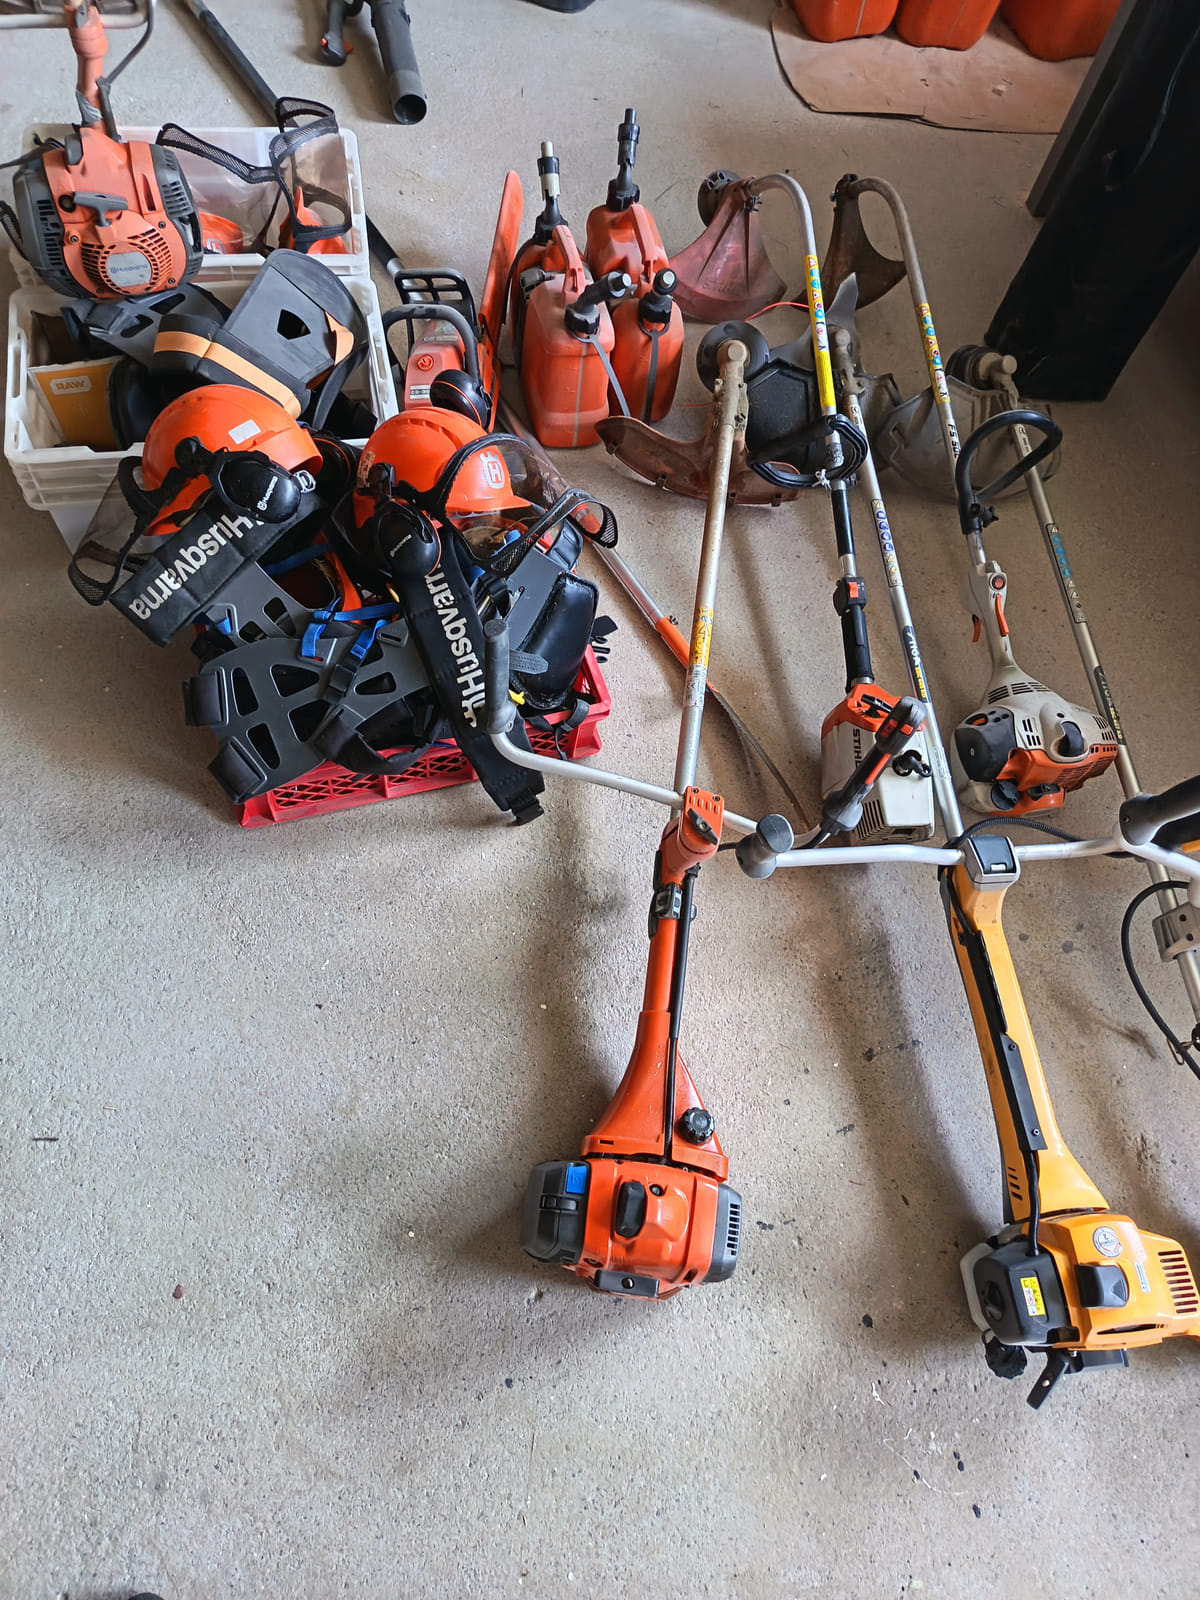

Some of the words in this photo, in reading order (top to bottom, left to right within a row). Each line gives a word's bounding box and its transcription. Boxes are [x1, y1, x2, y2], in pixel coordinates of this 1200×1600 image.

[55, 381, 85, 391] RAW
[128, 514, 253, 620] Husqvarna
[425, 563, 486, 698] Husqvarn
[852, 728, 862, 768] STIHL
